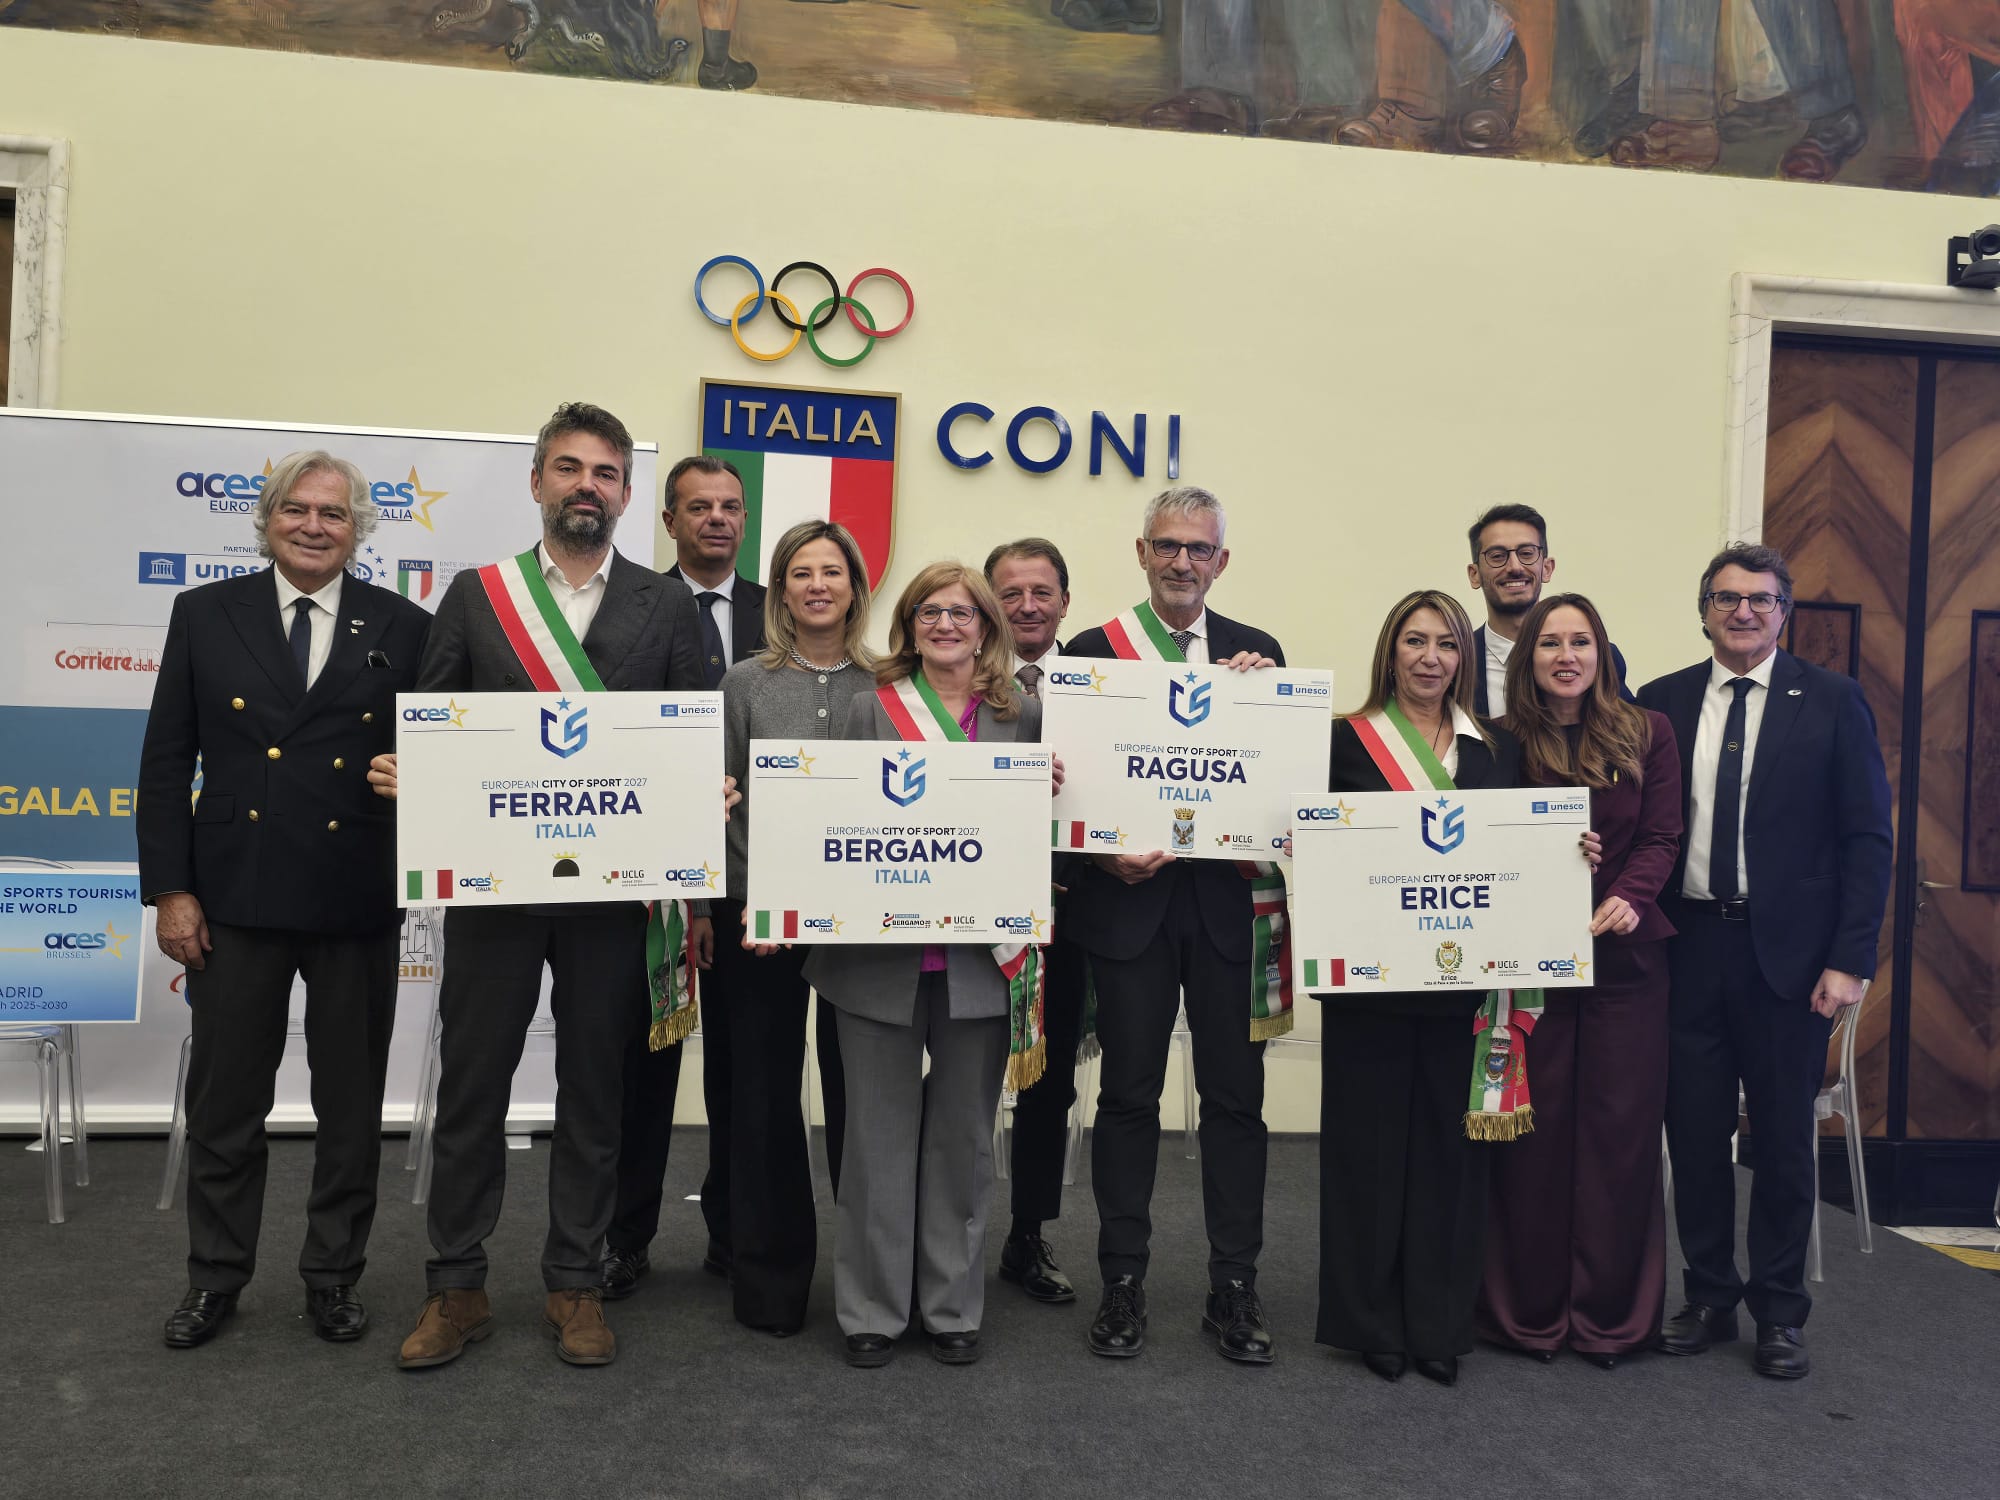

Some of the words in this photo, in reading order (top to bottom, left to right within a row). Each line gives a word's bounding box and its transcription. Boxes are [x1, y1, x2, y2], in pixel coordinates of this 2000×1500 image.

[723, 399, 882, 446] ITALIA
[936, 401, 1181, 480] CONI
[176, 471, 271, 499] aces
[369, 481, 414, 507] es
[210, 500, 256, 512] EUROP
[195, 563, 260, 579] unes
[400, 561, 431, 570] ITALIA
[55, 650, 132, 671] Corriere
[1050, 670, 1091, 686] aces
[1295, 685, 1328, 695] unesco
[403, 706, 451, 722] aces
[681, 706, 717, 714] unesco
[1114, 743, 1165, 753] EUROPEAN
[1166, 746, 1189, 755] CITY
[1190, 747, 1204, 755] OF
[1206, 748, 1237, 758] SPORT
[1239, 750, 1261, 758] 2027
[755, 754, 800, 769] aces
[1012, 758, 1047, 767] unesco
[1127, 755, 1247, 784] RAGUSA
[481, 780, 539, 790] EUROPEAN
[542, 779, 567, 788] CITY
[569, 779, 584, 788] OF
[586, 778, 622, 788] SPORT
[624, 777, 648, 787] 2027
[1159, 786, 1212, 802] ITALIA
[0, 786, 100, 816] GALA
[489, 790, 643, 818] FERRARA
[1550, 802, 1584, 811] unesco
[1297, 807, 1340, 820] aces
[536, 823, 597, 839] ITALIA
[826, 827, 879, 835] EUROPEAN
[881, 827, 905, 836] CITY
[906, 827, 921, 836] OF
[922, 827, 956, 836] SPORT
[957, 827, 980, 836] 2027
[1090, 829, 1118, 840] aces
[1232, 835, 1253, 843] UCLG
[824, 838, 983, 863] BERGAMO
[622, 870, 645, 878] UCLG
[665, 868, 706, 881] aces
[875, 869, 932, 884] ITALIA
[1369, 875, 1421, 884] EUROPEAN
[1423, 874, 1446, 883] CITY
[1448, 874, 1462, 882] OF
[1463, 873, 1497, 882] SPORT
[1498, 872, 1520, 881] 2027
[460, 878, 492, 887] aces
[3, 887, 63, 899] SPORTS
[68, 888, 137, 899] TOURISM
[1401, 885, 1490, 910] ERICE
[19, 903, 78, 914] WORLD
[804, 917, 833, 928] aces
[953, 915, 975, 924] UCLG
[994, 915, 1032, 929] aces
[1418, 915, 1474, 931] ITALIA
[44, 932, 106, 950] aces
[46, 951, 92, 959] BRUSSELS
[1351, 966, 1380, 976] aces
[1497, 960, 1519, 969] UCLG
[1538, 959, 1576, 972] aces
